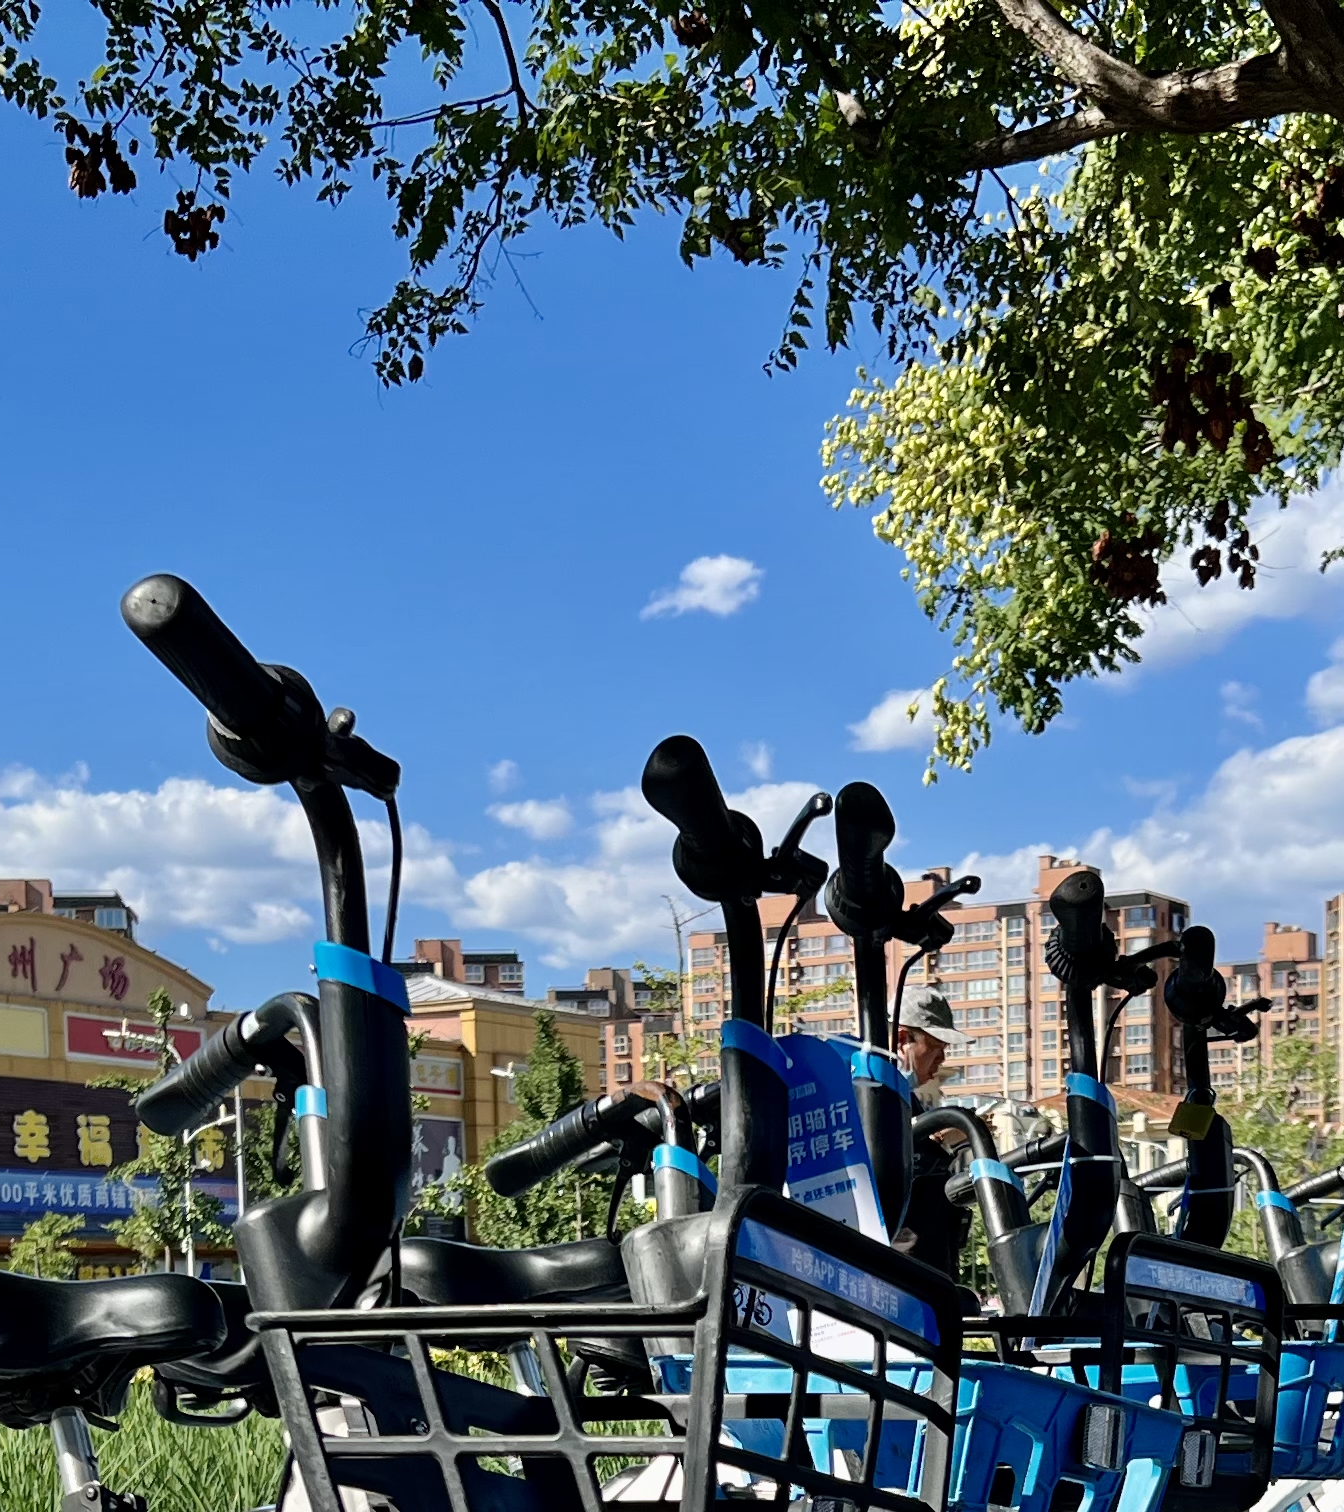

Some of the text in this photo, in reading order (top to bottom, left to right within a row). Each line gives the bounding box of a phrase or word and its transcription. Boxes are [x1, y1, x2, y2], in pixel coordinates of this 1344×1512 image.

[788, 1100, 849, 1139] 明骑行
[788, 1128, 855, 1166] 序停车
